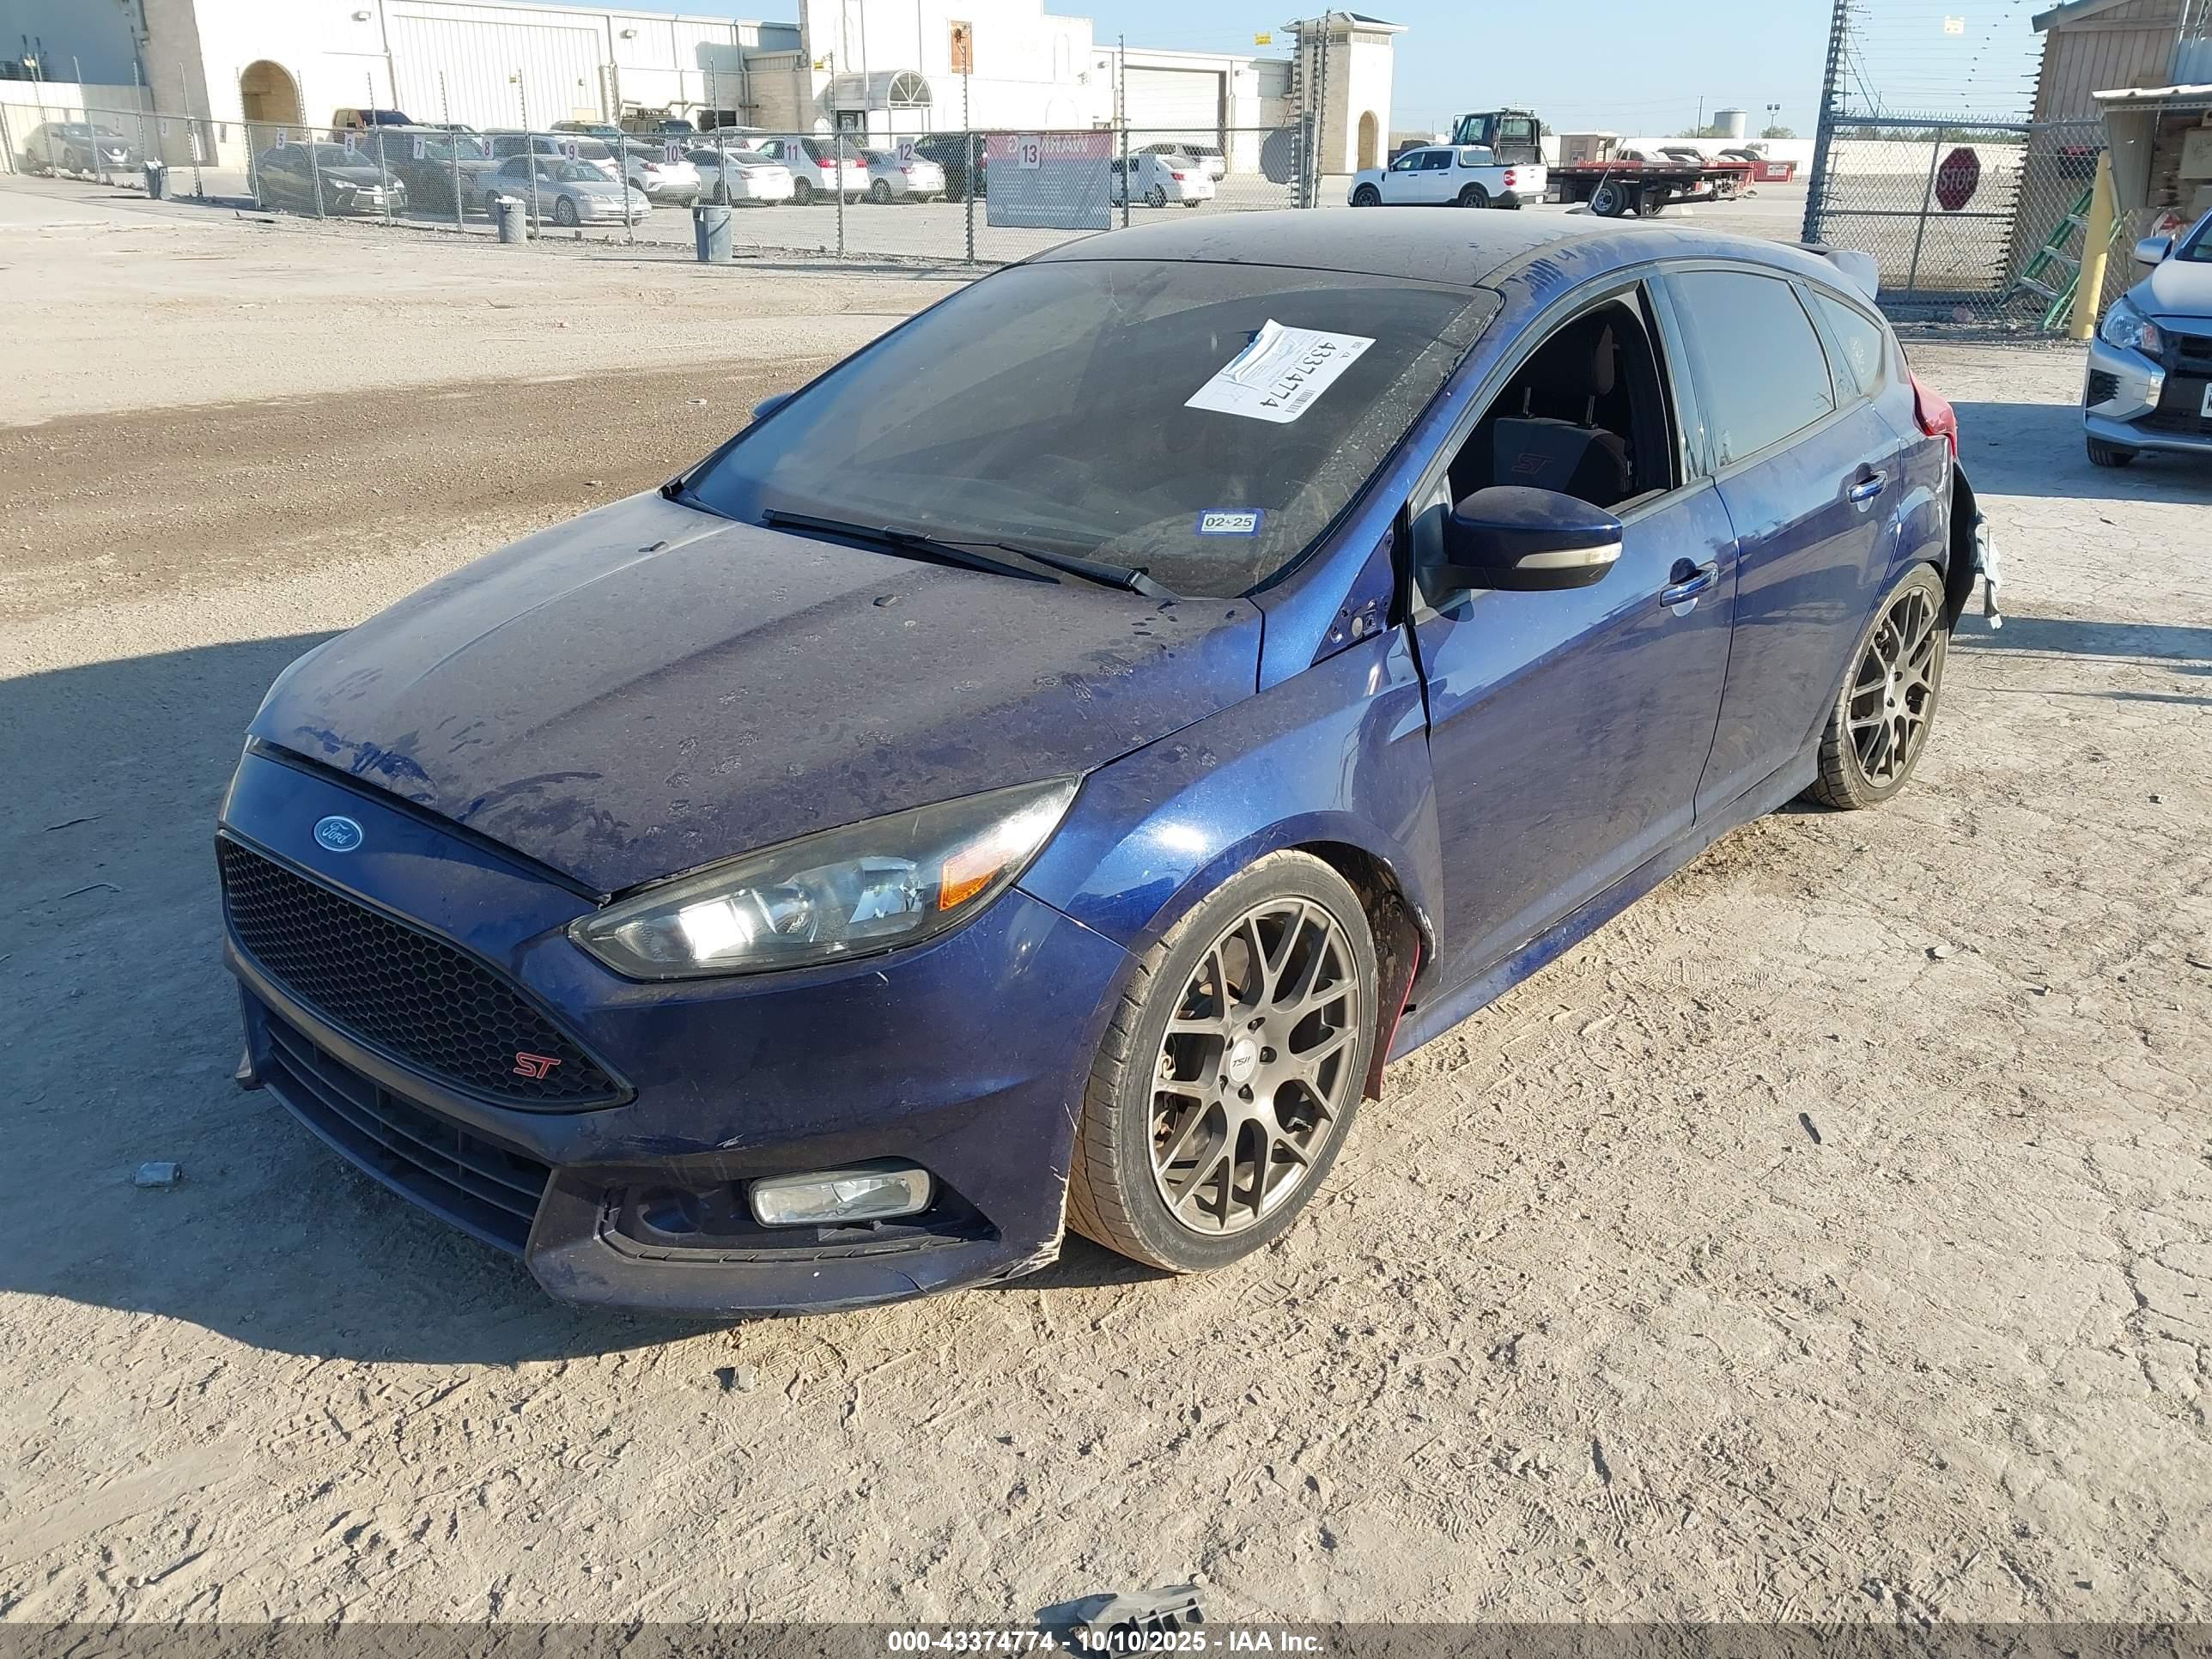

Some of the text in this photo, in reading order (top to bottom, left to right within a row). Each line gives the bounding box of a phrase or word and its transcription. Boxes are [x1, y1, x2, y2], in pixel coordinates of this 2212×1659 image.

[278, 133, 283, 145] 5
[347, 138, 352, 152] 6
[417, 142, 422, 155] 7
[484, 141, 490, 155] 8
[568, 145, 575, 161] 9
[665, 145, 678, 162] 10
[787, 144, 798, 161] 11
[898, 143, 912, 161] 12
[1022, 144, 1037, 163] 13
[1939, 167, 1977, 191] STOP
[1259, 342, 1336, 408] 43374774
[322, 822, 351, 845] Ford
[513, 1052, 562, 1079] ST
